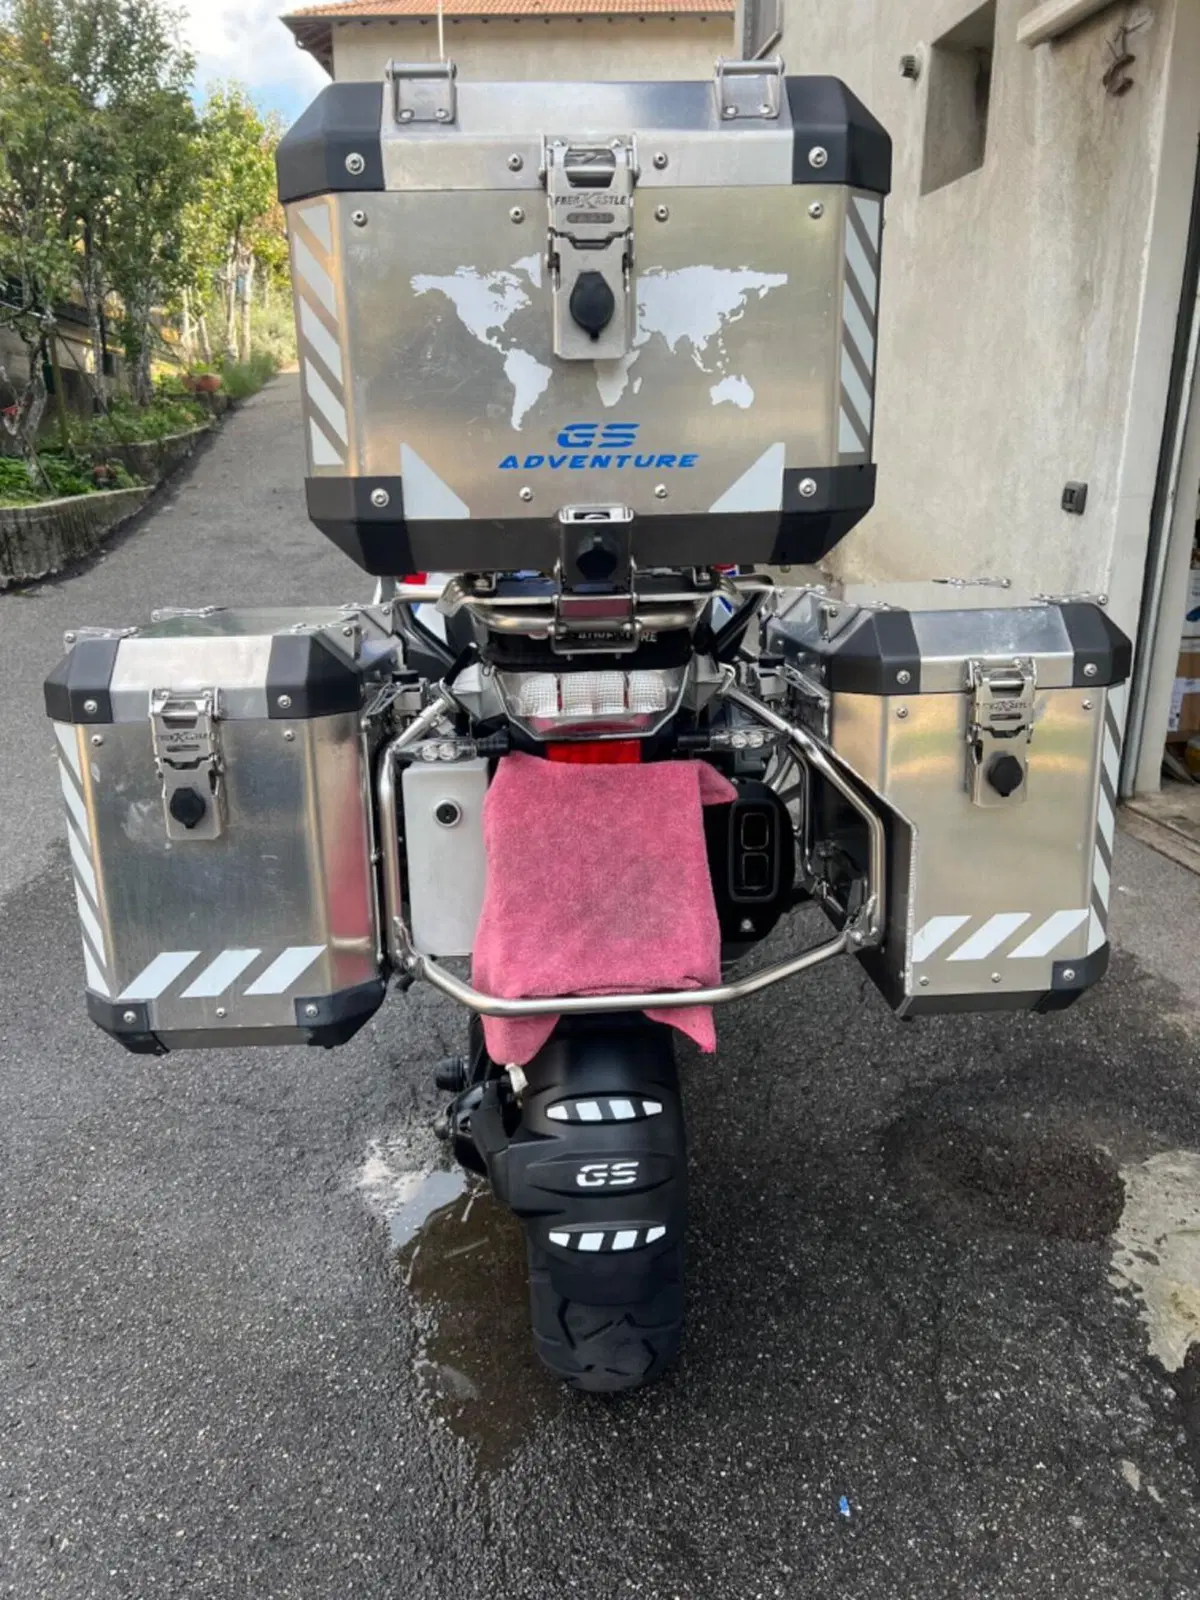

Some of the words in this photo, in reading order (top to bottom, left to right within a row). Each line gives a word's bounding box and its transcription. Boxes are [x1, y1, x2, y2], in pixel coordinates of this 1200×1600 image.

[557, 423, 640, 448] GS
[499, 454, 699, 469] ADVENTURE
[576, 1161, 639, 1187] GS
